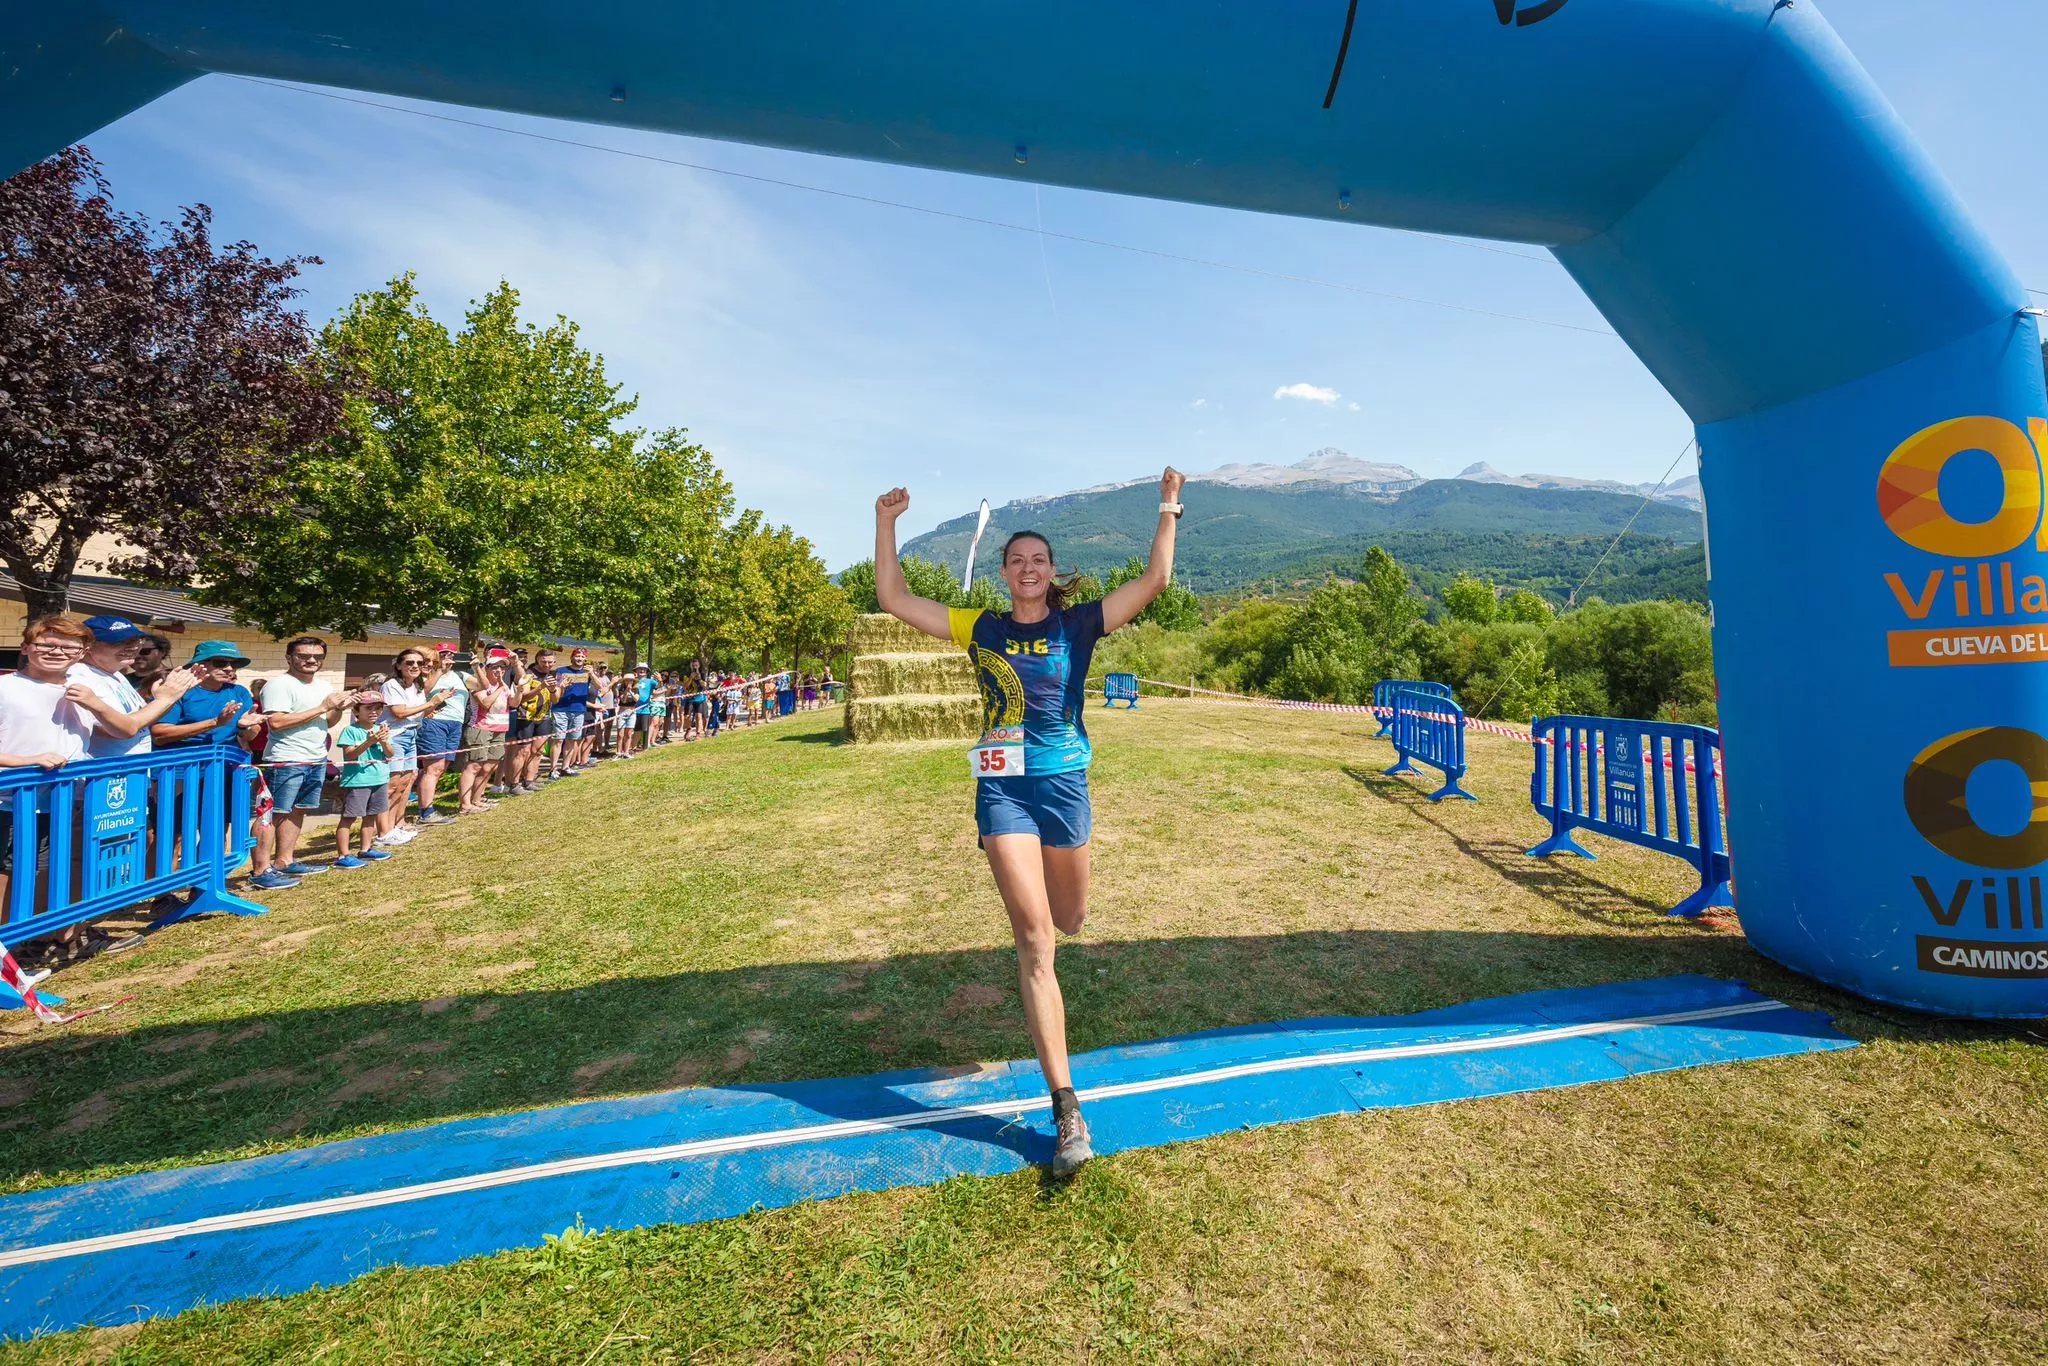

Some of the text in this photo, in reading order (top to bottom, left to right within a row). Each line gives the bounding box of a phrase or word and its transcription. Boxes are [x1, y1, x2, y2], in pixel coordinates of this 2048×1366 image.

[1925, 635, 2007, 656] CUEVA
[2010, 633, 2036, 653] DE
[980, 749, 1005, 771] 55
[1932, 946, 2048, 971] CAMINOS
